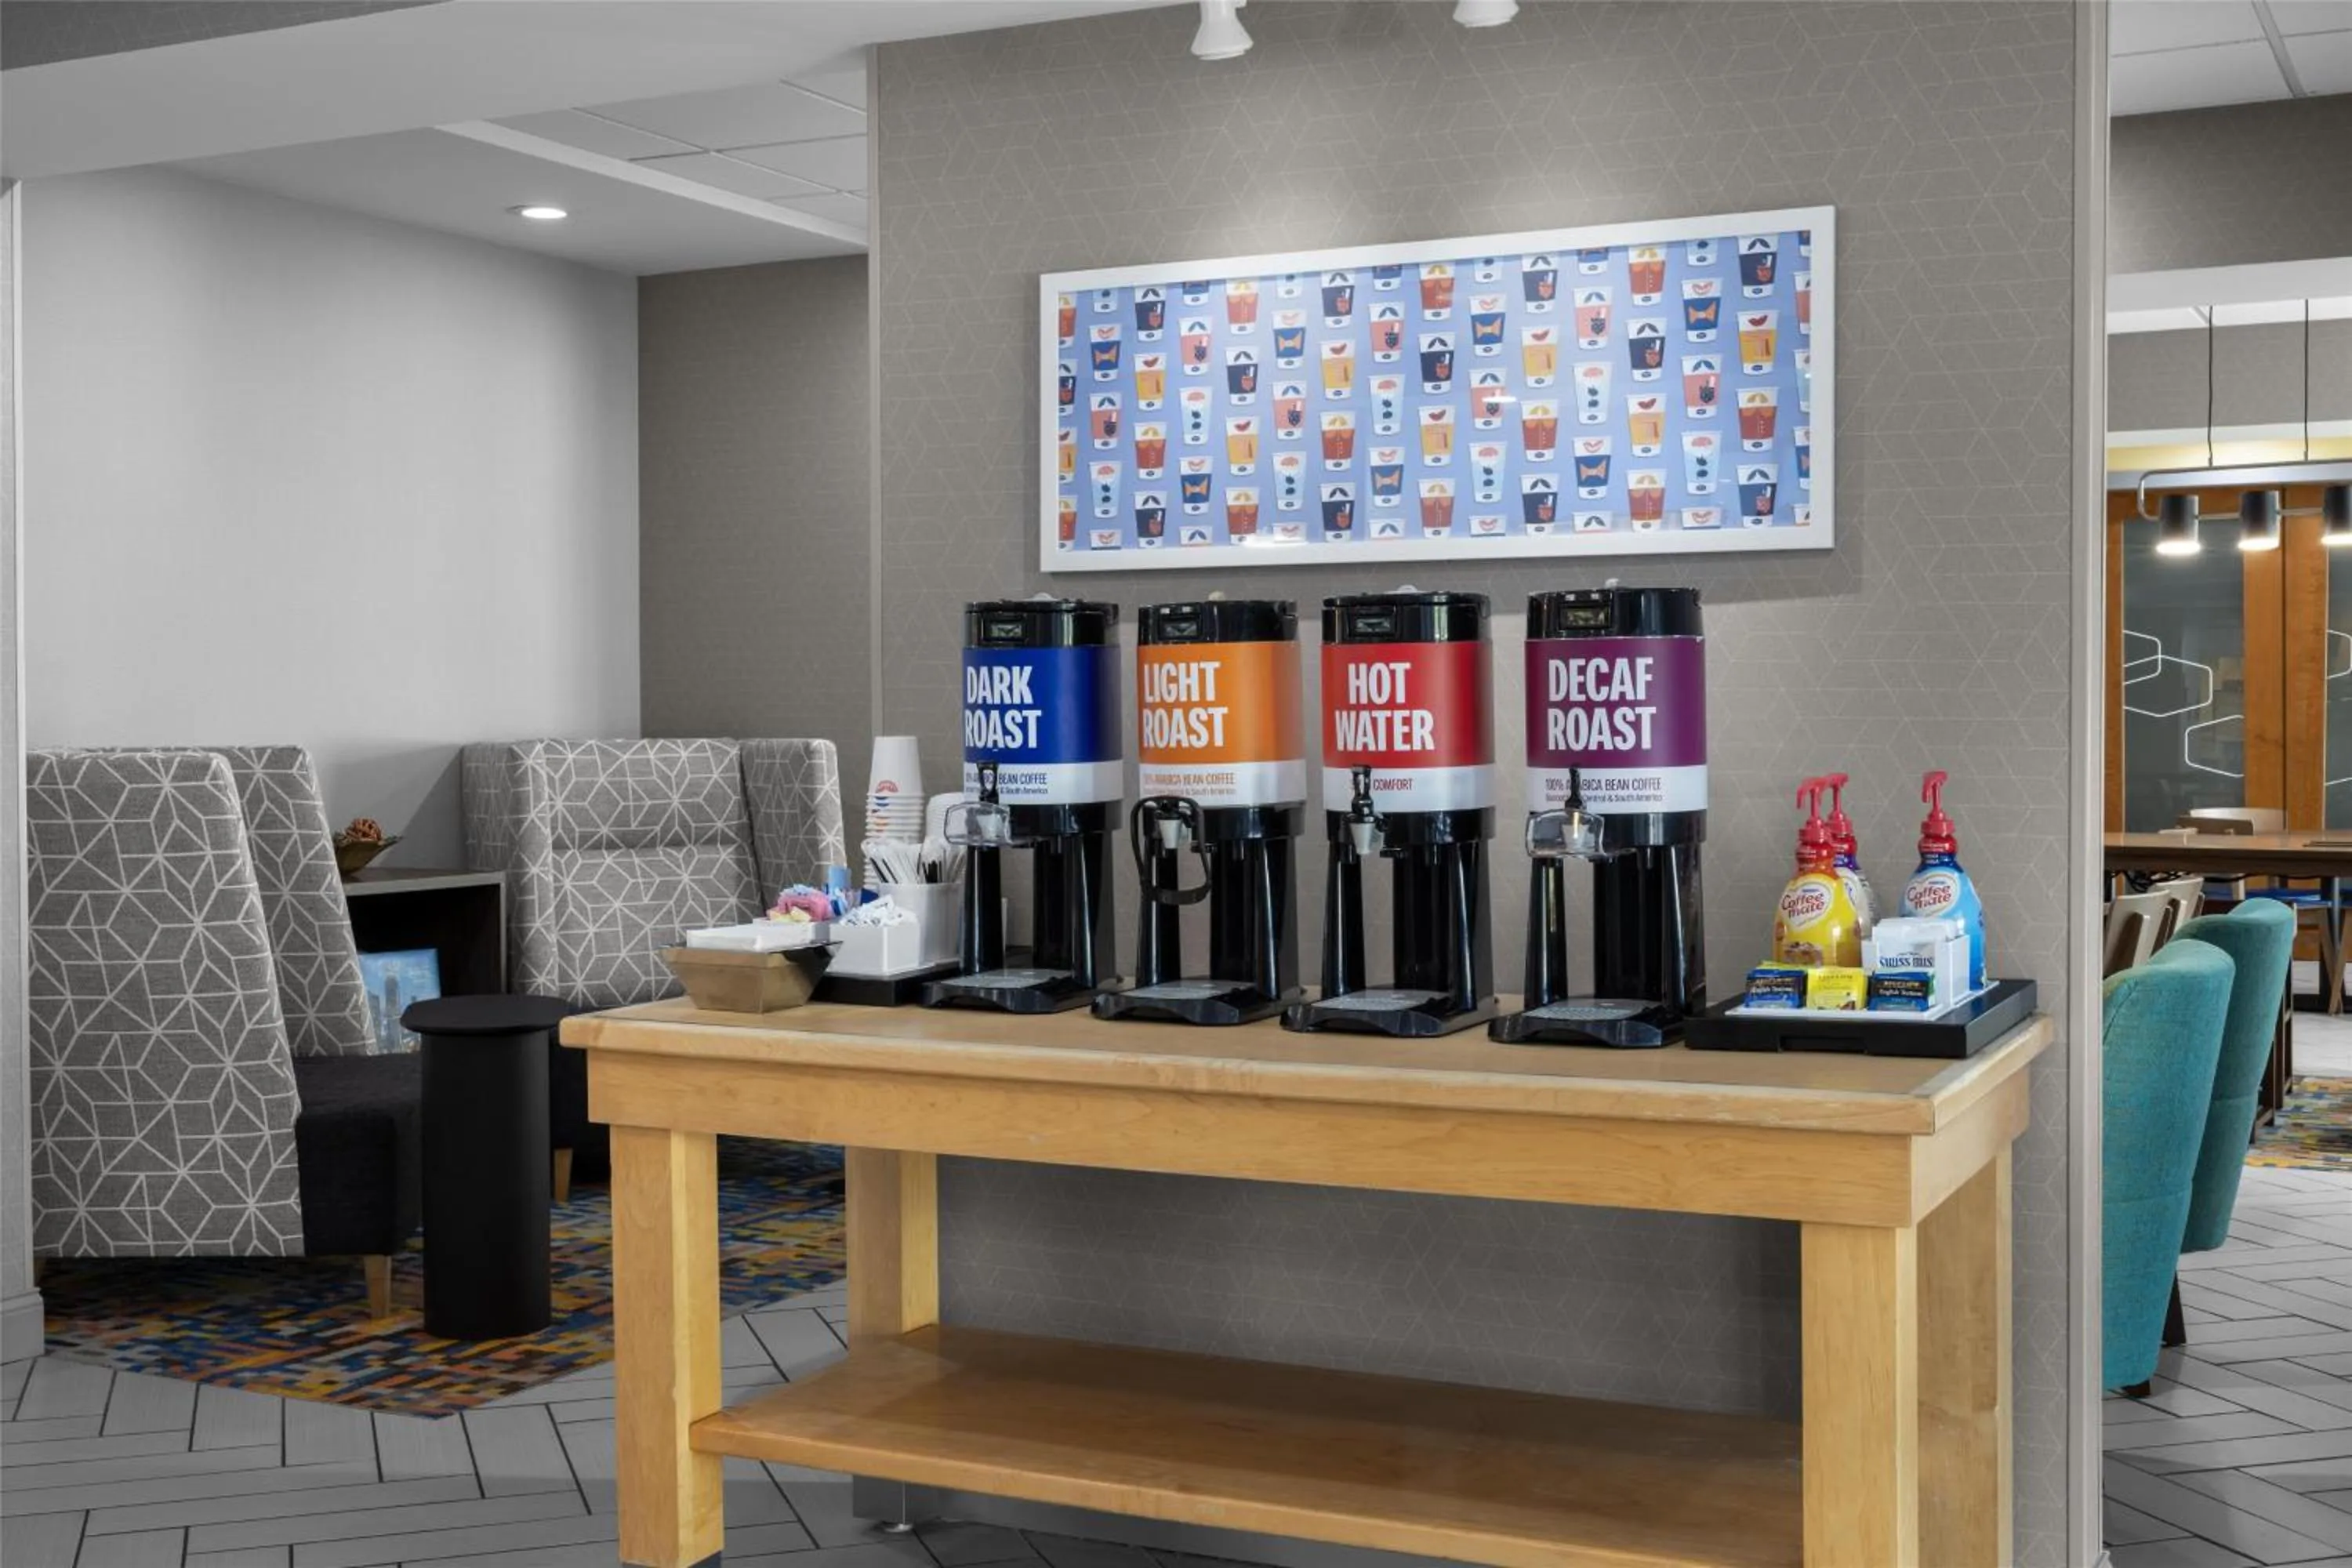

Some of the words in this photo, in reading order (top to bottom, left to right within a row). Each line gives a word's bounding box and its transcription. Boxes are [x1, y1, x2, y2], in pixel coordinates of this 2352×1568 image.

[967, 666, 1034, 704] DARK
[1144, 661, 1221, 703] LIGHT
[1348, 662, 1412, 705] HOT
[1548, 657, 1653, 702] DECAF
[964, 709, 1042, 749] ROAST
[1142, 707, 1229, 749] ROAST
[1335, 709, 1435, 752] WATER
[1547, 706, 1657, 751] ROAST
[998, 772, 1018, 785] BEAN
[1019, 772, 1047, 785] COFFEE
[1205, 772, 1236, 785] COFFEE
[1373, 778, 1414, 791] COMFORT
[1605, 778, 1630, 791] BEAN
[1632, 777, 1661, 790] COFFEE
[1781, 892, 1824, 910] Coffee
[1907, 884, 1951, 902] Coffee
[1915, 893, 1951, 910] mate
[1788, 900, 1824, 919] mate
